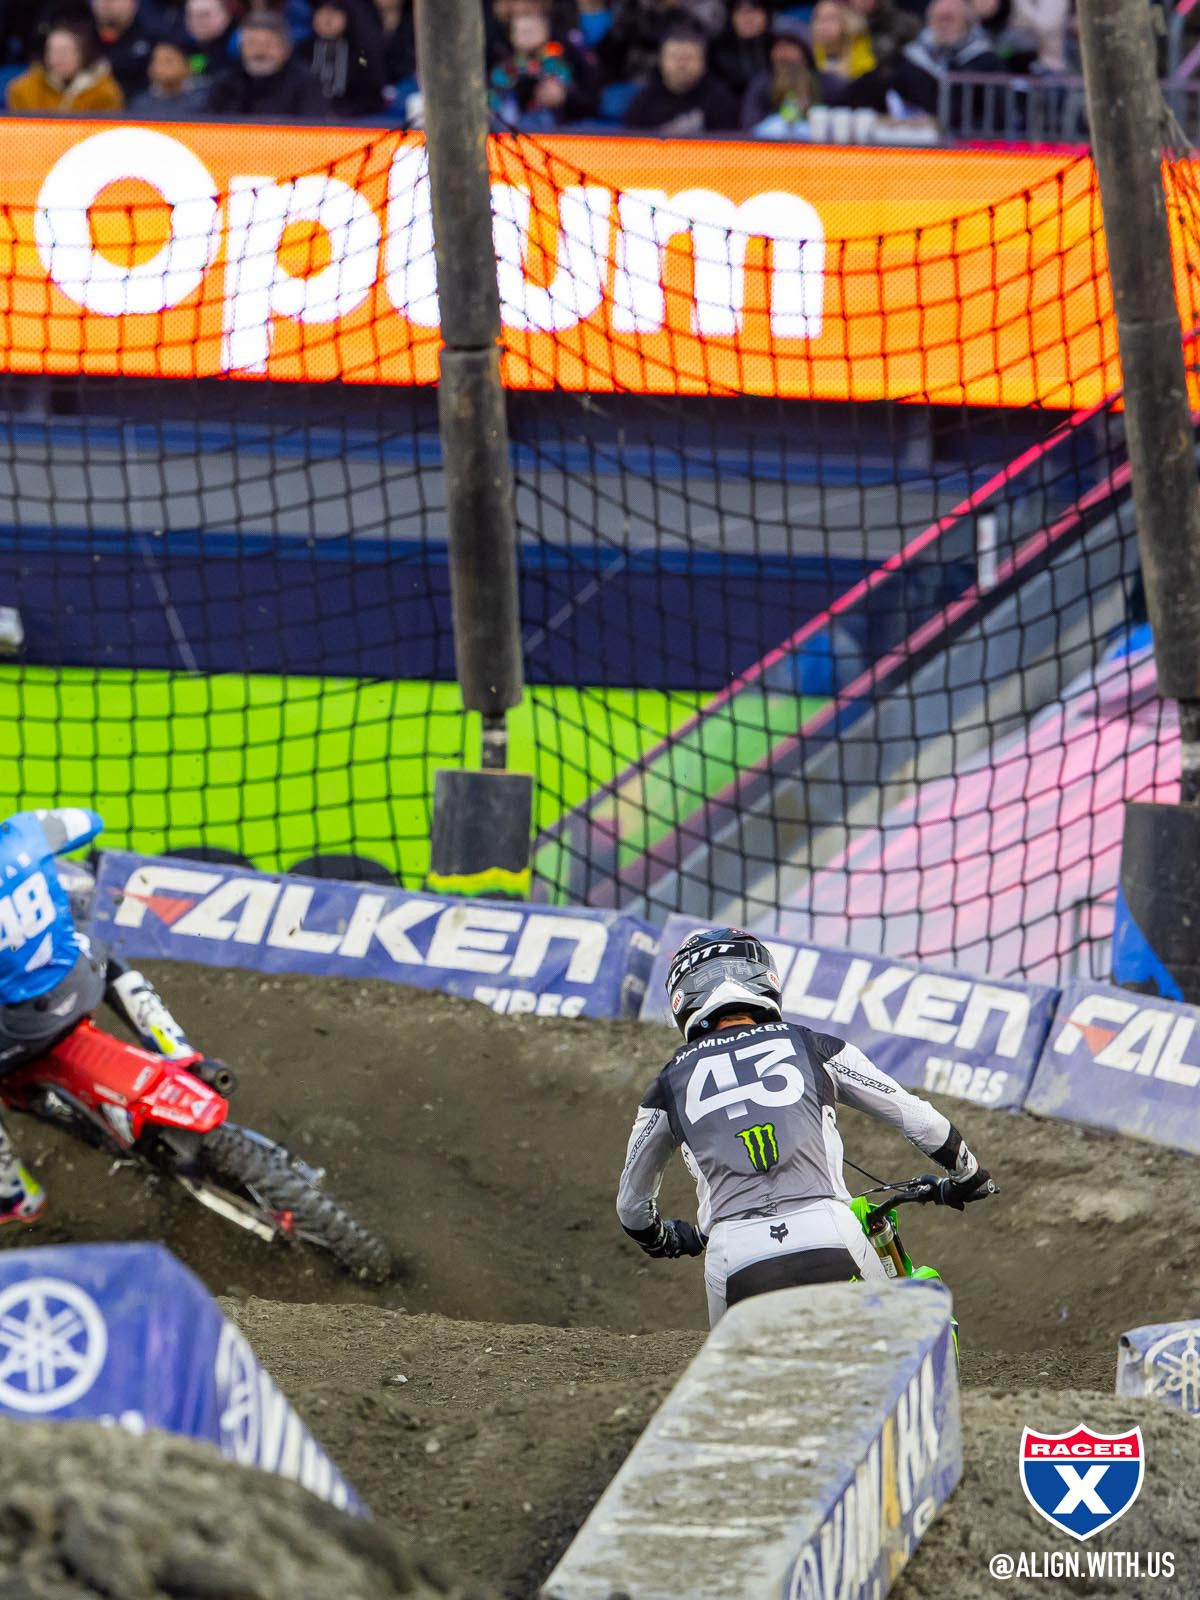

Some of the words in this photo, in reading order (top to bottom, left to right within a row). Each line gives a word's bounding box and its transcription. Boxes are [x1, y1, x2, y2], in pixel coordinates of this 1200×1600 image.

[34, 127, 825, 373] Optum
[114, 865, 608, 984] FALKEN
[675, 1023, 790, 1065] HAMMAKER
[685, 1038, 805, 1126] 43
[847, 1070, 897, 1095] CIRCUIT
[924, 1056, 1009, 1103] TIRES
